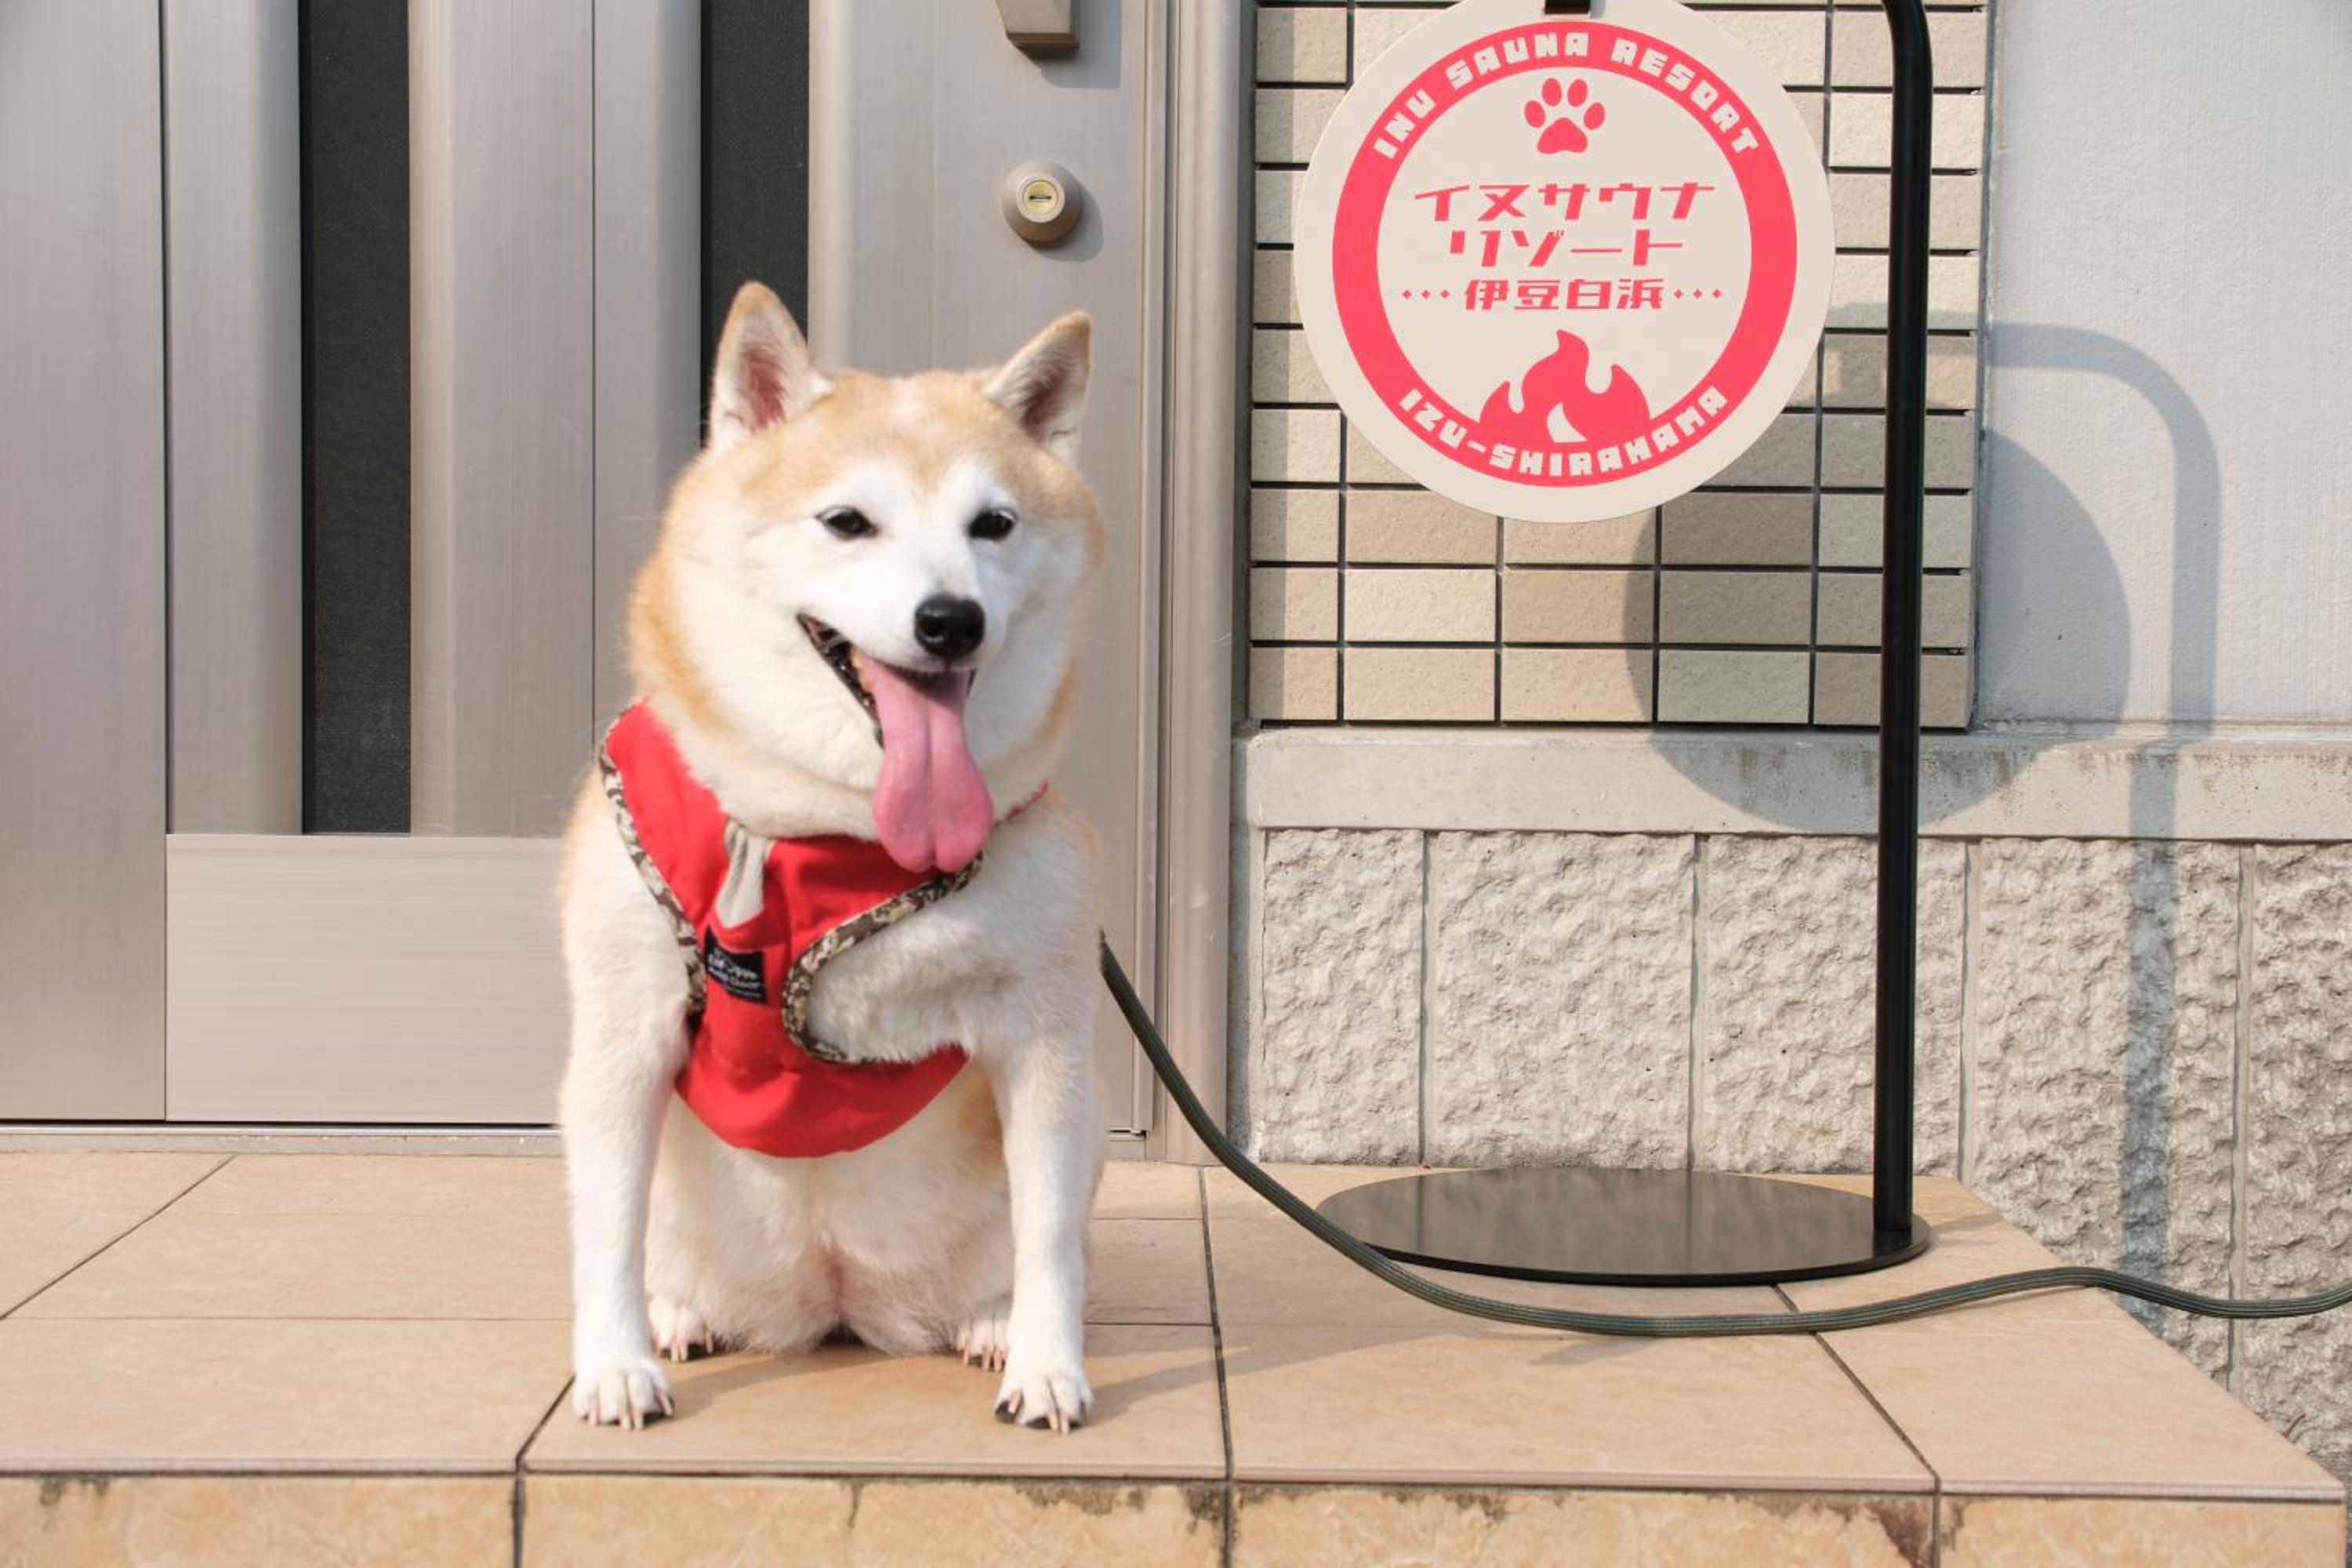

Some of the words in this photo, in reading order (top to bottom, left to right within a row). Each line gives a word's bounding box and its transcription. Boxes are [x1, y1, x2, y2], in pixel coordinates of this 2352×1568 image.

[1374, 89, 1437, 159] INU
[1446, 32, 1589, 89] SAUNA
[1611, 39, 1758, 156] RESORT
[1414, 181, 1715, 222] イヌサウナ
[1450, 228, 1682, 267] リゾート
[1465, 278, 1665, 310] 伊豆白浜
[1399, 387, 1728, 477] IZU-SHIRAHAMA
